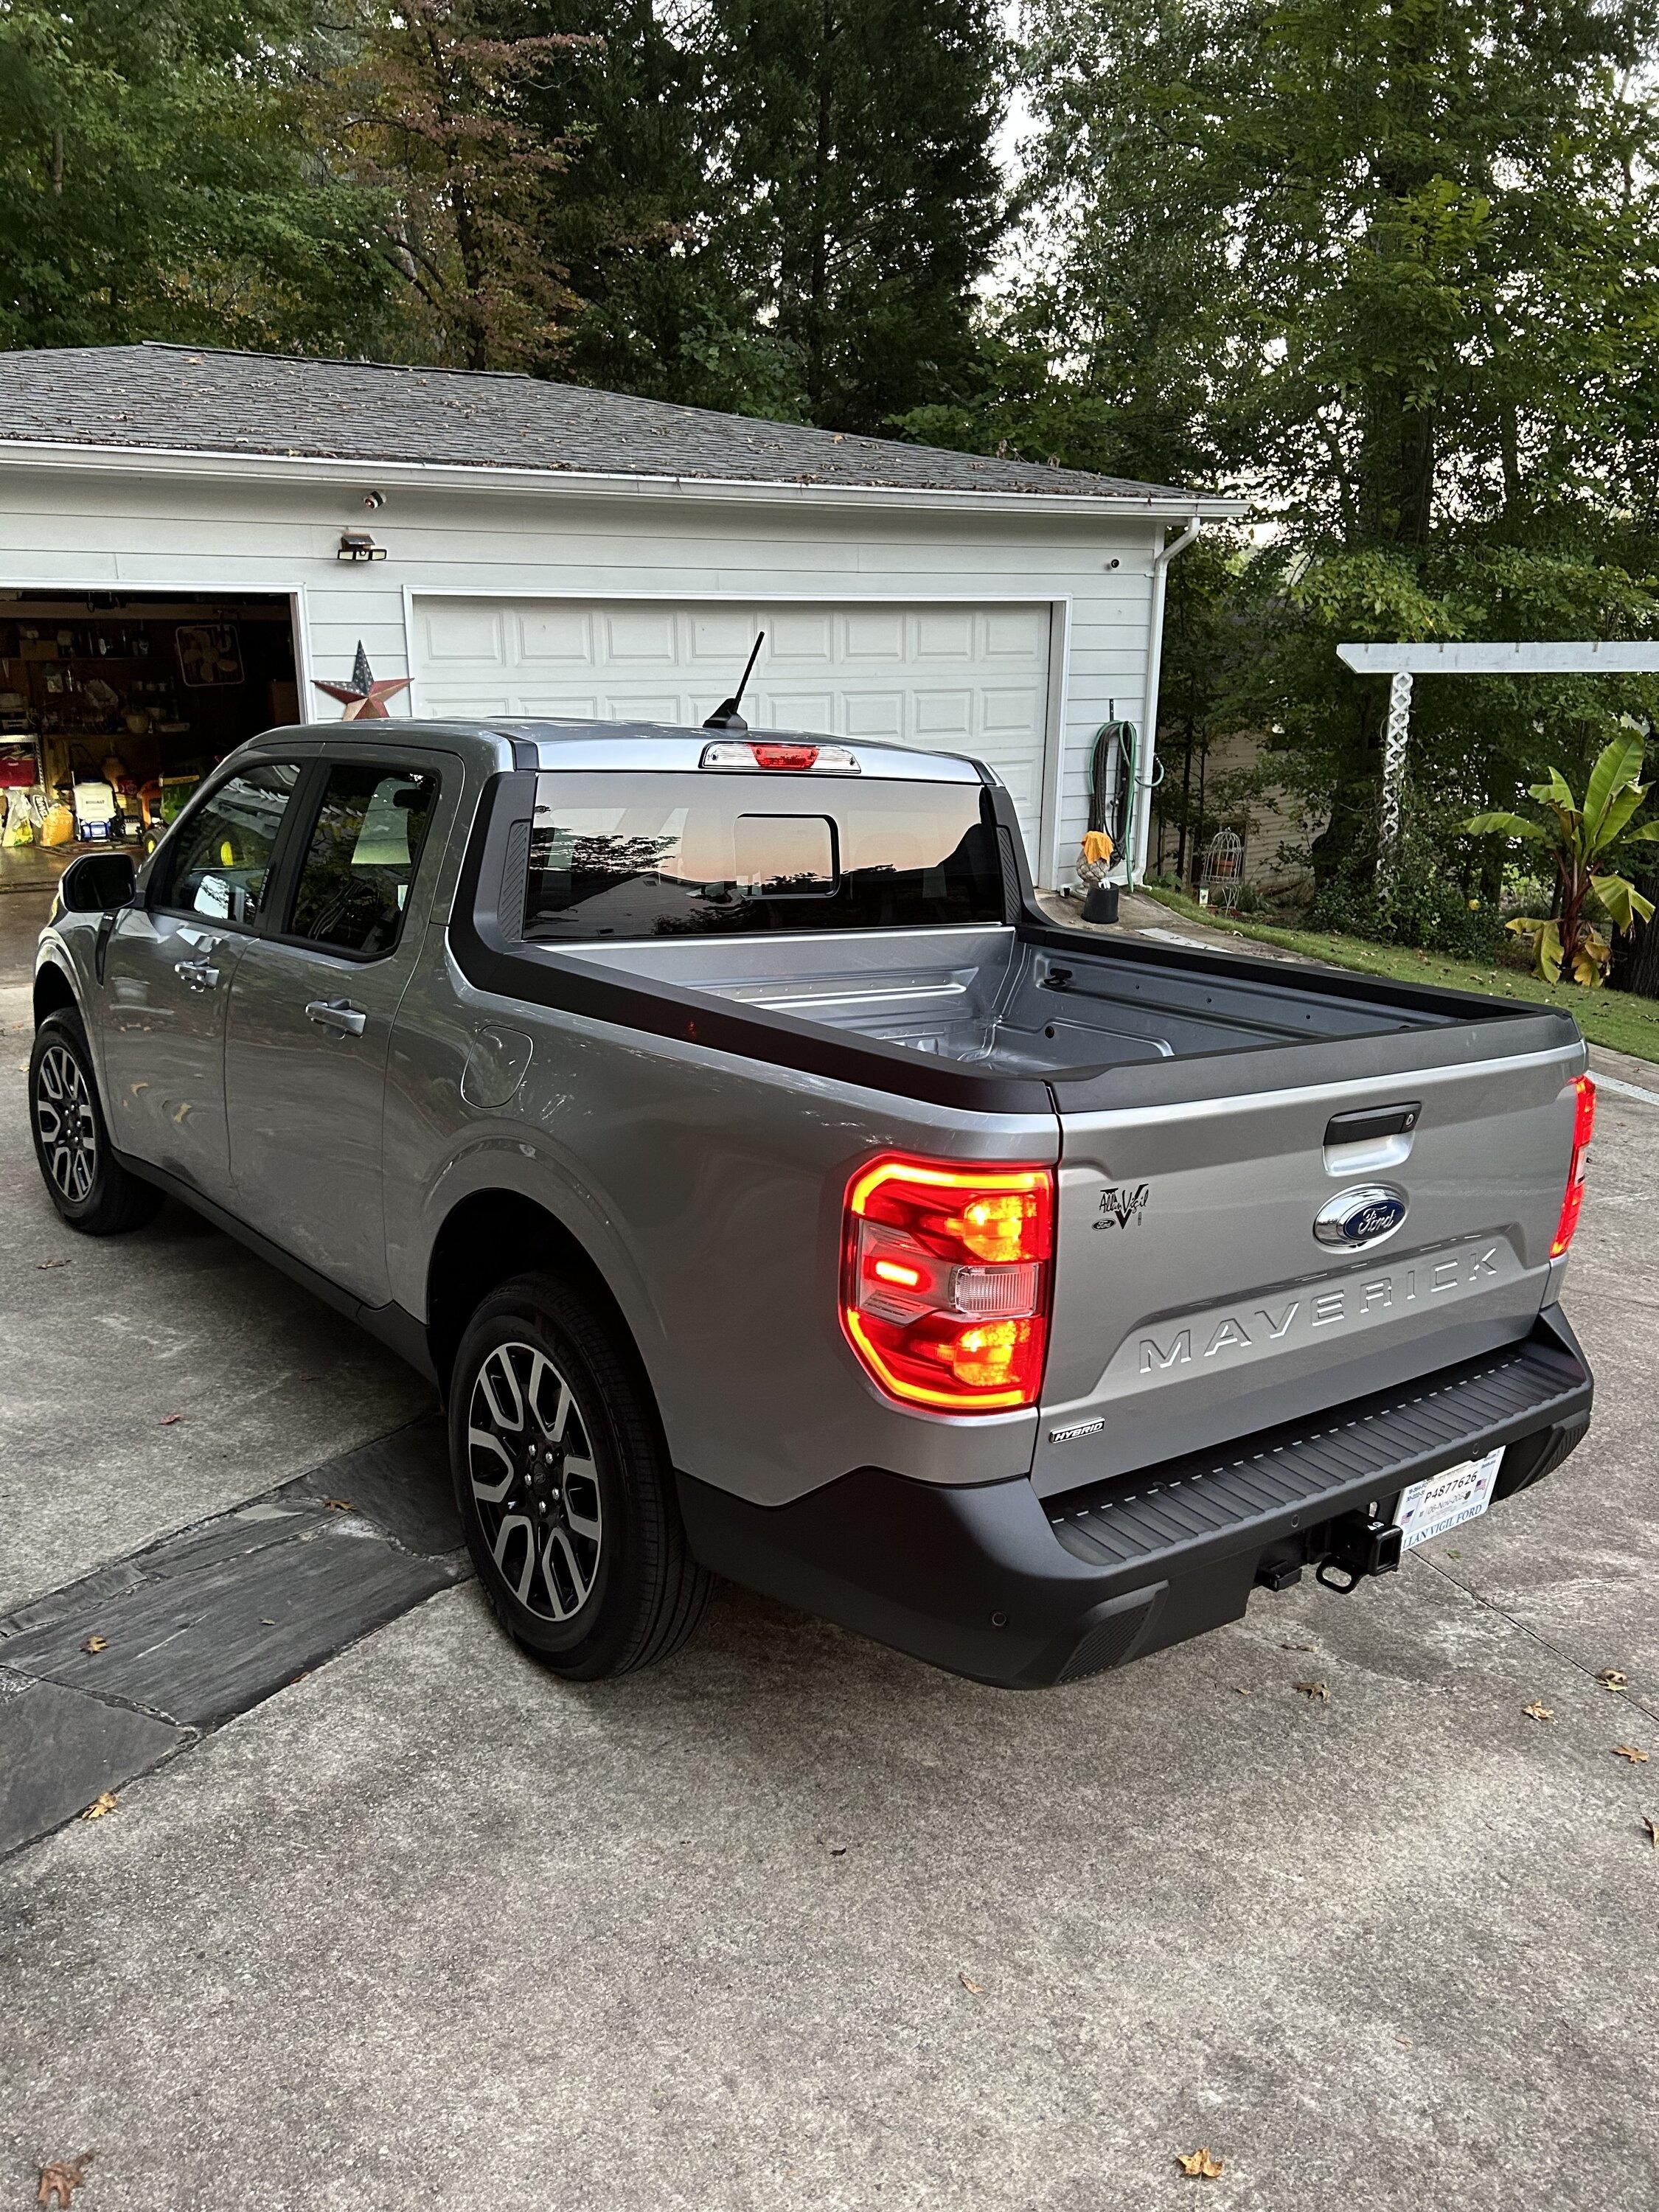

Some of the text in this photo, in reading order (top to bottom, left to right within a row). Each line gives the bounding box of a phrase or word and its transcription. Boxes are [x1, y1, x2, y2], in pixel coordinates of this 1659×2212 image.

[1357, 1206, 1395, 1234] Ford
[1139, 1247, 1498, 1374] MAVERICK
[1054, 1422, 1103, 1441] HYBRID
[1424, 1471, 1478, 1503] P4877626
[1403, 1528, 1428, 1548] LLAN
[1430, 1517, 1455, 1534] VIGIL
[1456, 1504, 1482, 1523] FORD
